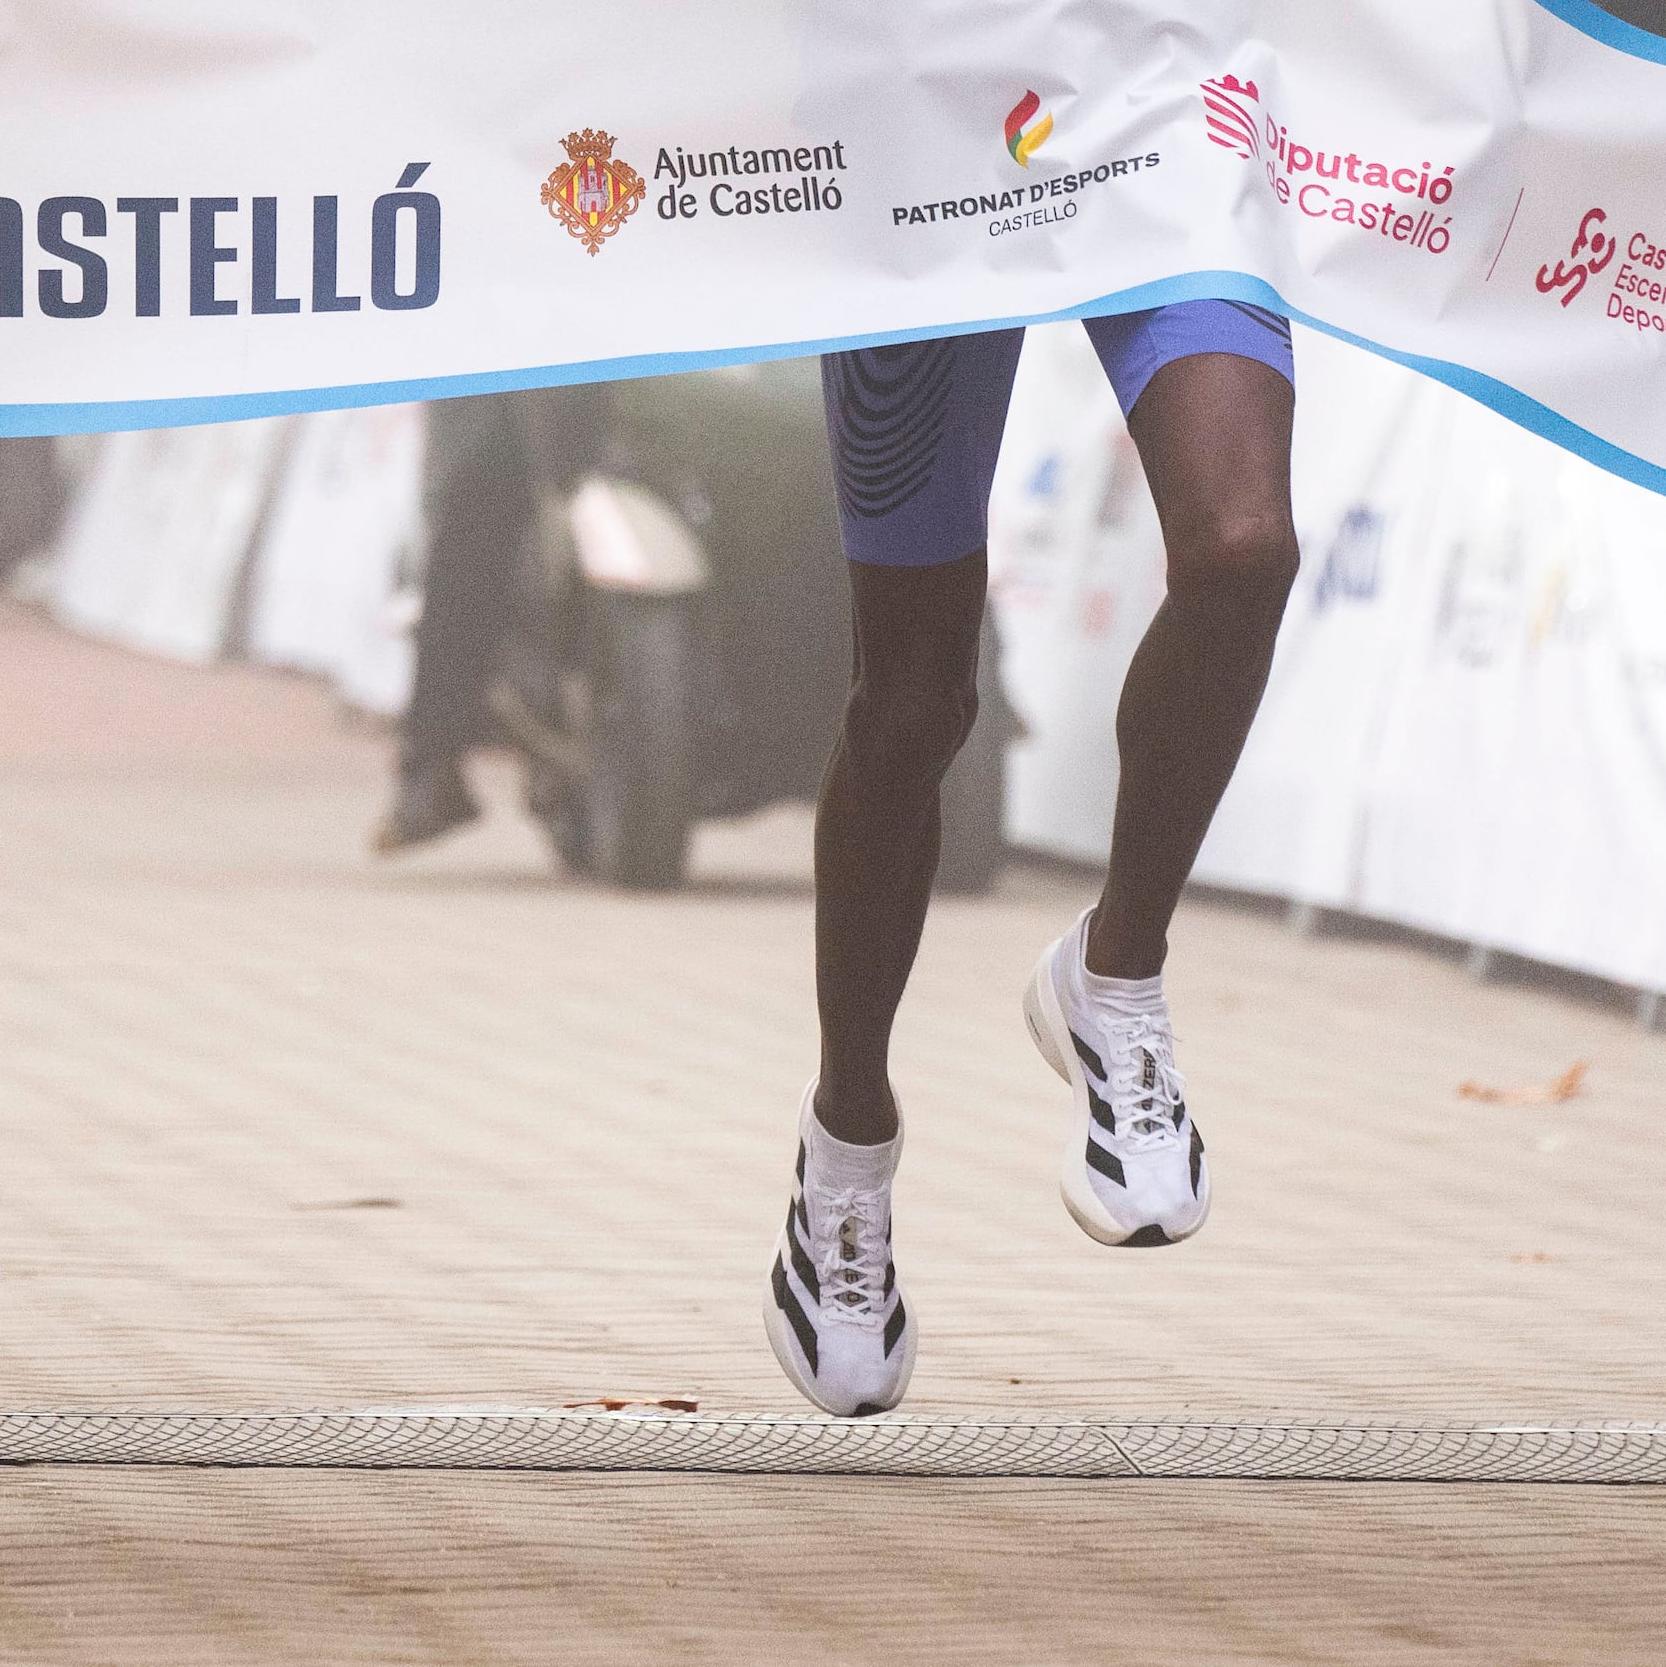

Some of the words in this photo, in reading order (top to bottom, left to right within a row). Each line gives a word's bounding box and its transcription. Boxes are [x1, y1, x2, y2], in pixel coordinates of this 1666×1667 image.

[653, 140, 847, 189] Ajuntament
[892, 188, 1026, 226] PATRONAT
[1029, 152, 1161, 203] D'ESPORTS
[1266, 112, 1456, 206] Diputació
[657, 185, 698, 220] de
[709, 177, 843, 217] Castelló
[989, 199, 1078, 236] CASTELLÓ
[1266, 160, 1291, 205] de
[1298, 184, 1453, 255] Castelló
